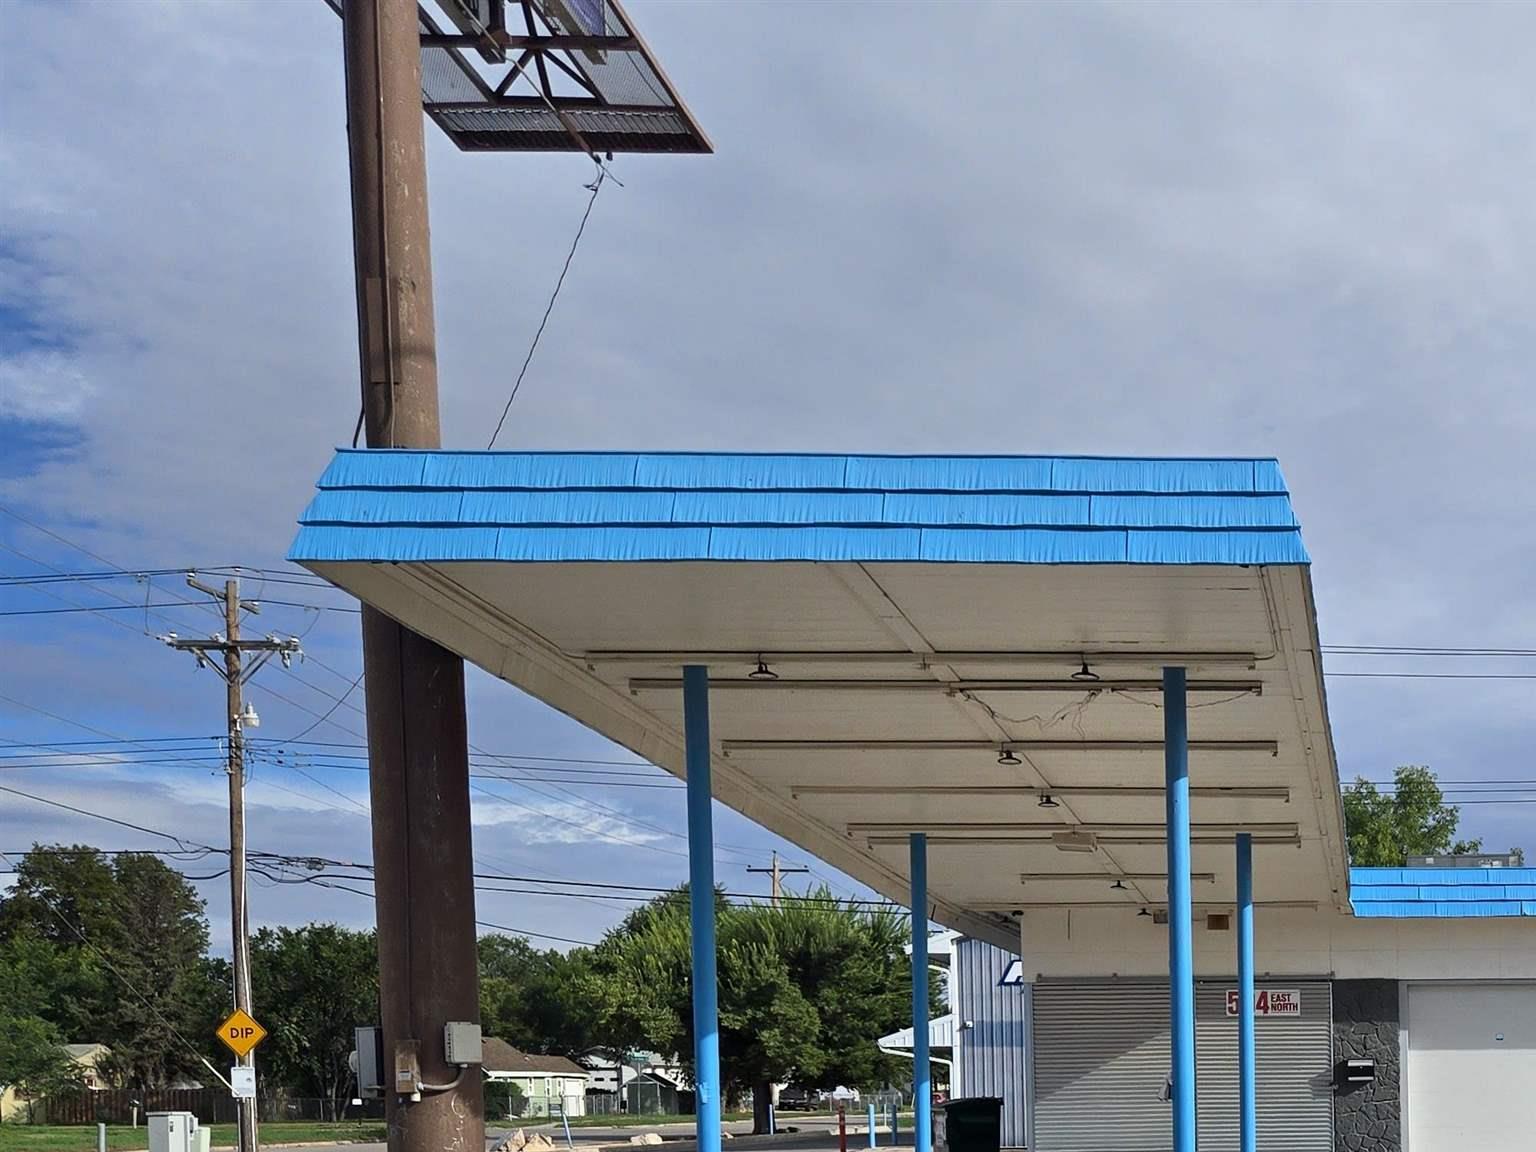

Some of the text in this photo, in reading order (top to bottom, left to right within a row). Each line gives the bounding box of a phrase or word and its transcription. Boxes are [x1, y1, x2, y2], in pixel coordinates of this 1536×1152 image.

[1228, 991, 1269, 1014] 54
[1271, 994, 1291, 1002] EAST
[1271, 1003, 1298, 1011] NORTH
[230, 1028, 254, 1038] DIP
